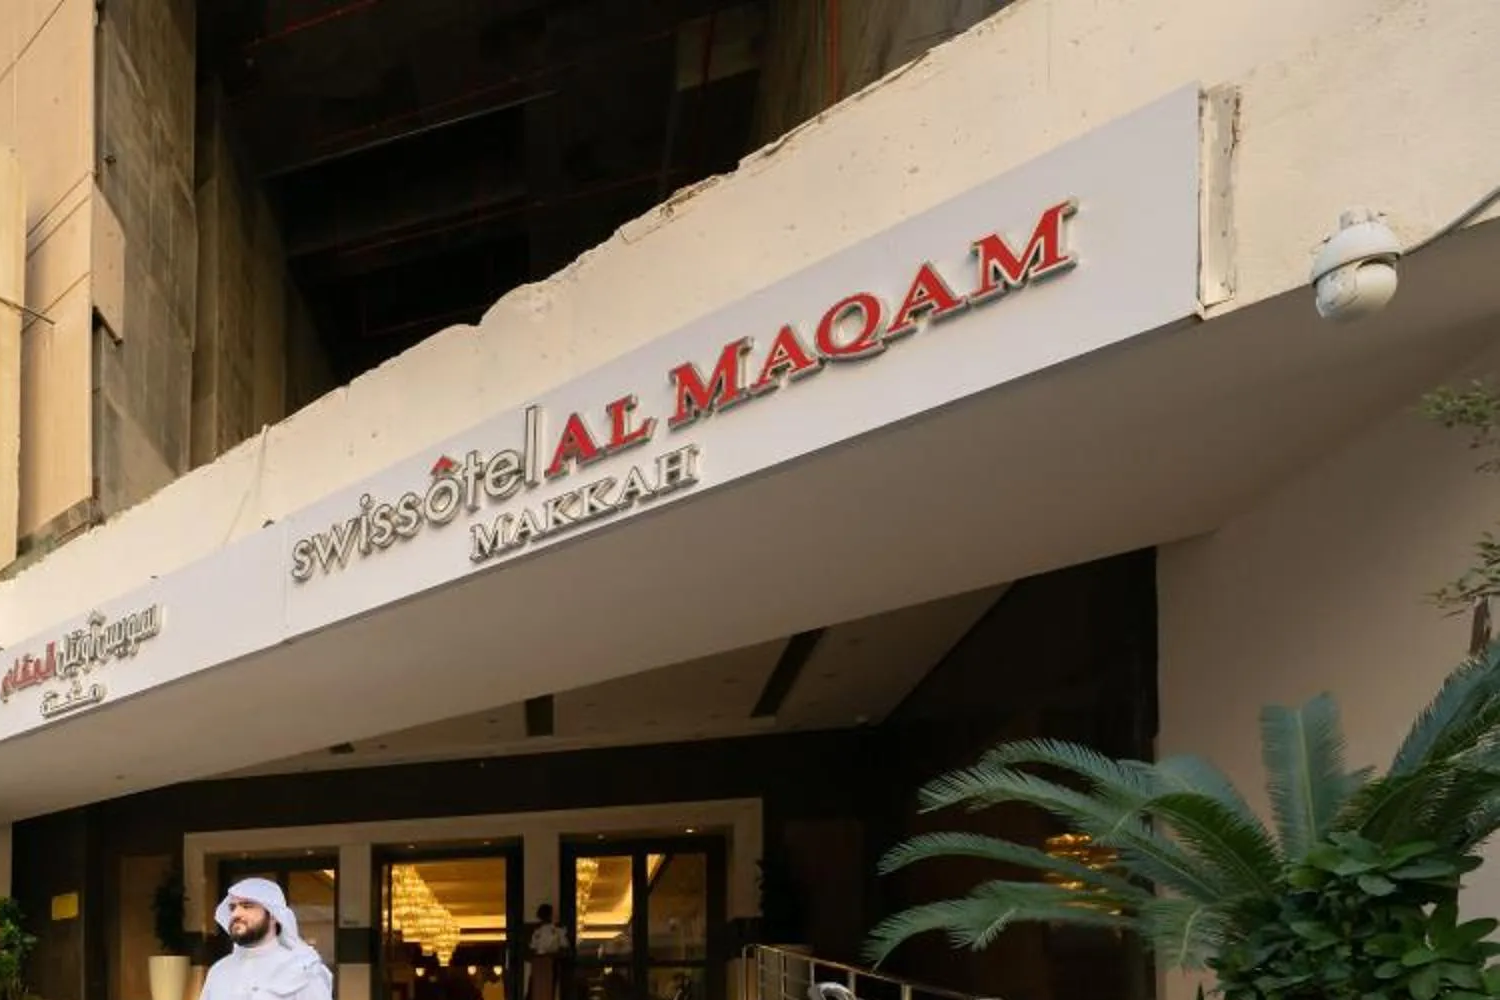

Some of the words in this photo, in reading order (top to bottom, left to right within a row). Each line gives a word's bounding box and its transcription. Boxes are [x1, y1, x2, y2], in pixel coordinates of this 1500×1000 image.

[292, 404, 544, 582] swissôtel
[545, 394, 658, 479] AL
[667, 199, 1079, 427] MAQAM
[469, 443, 700, 563] MAKKAH
[0, 640, 57, 704] المقام
